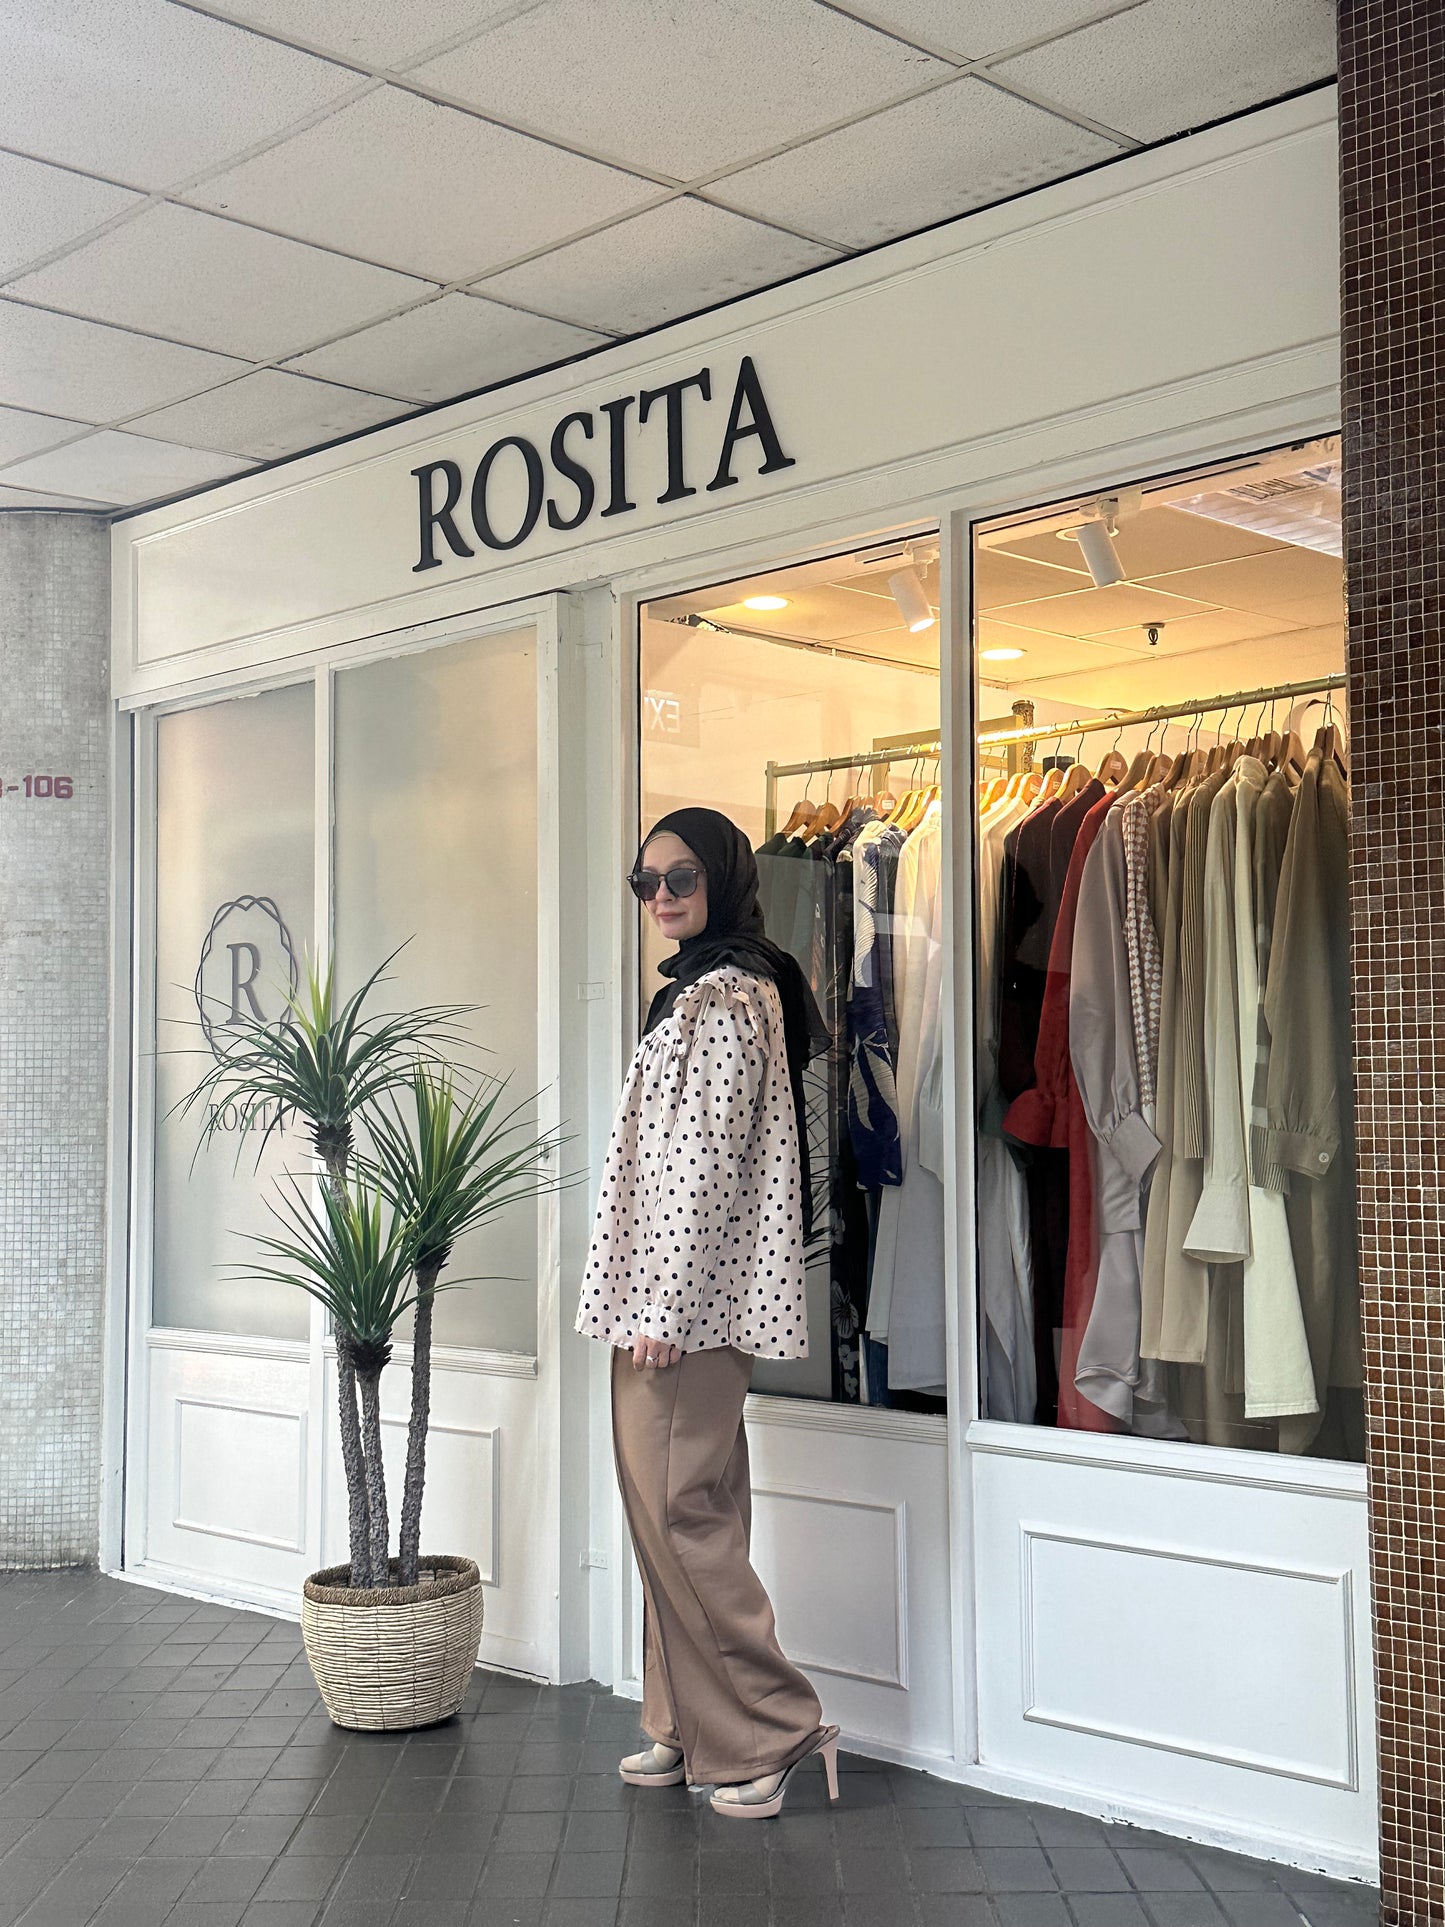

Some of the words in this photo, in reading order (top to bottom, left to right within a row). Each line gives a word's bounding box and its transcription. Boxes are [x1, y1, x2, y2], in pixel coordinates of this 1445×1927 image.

[411, 356, 796, 572] ROSITA
[0, 775, 74, 799] -106
[225, 942, 268, 1025] R
